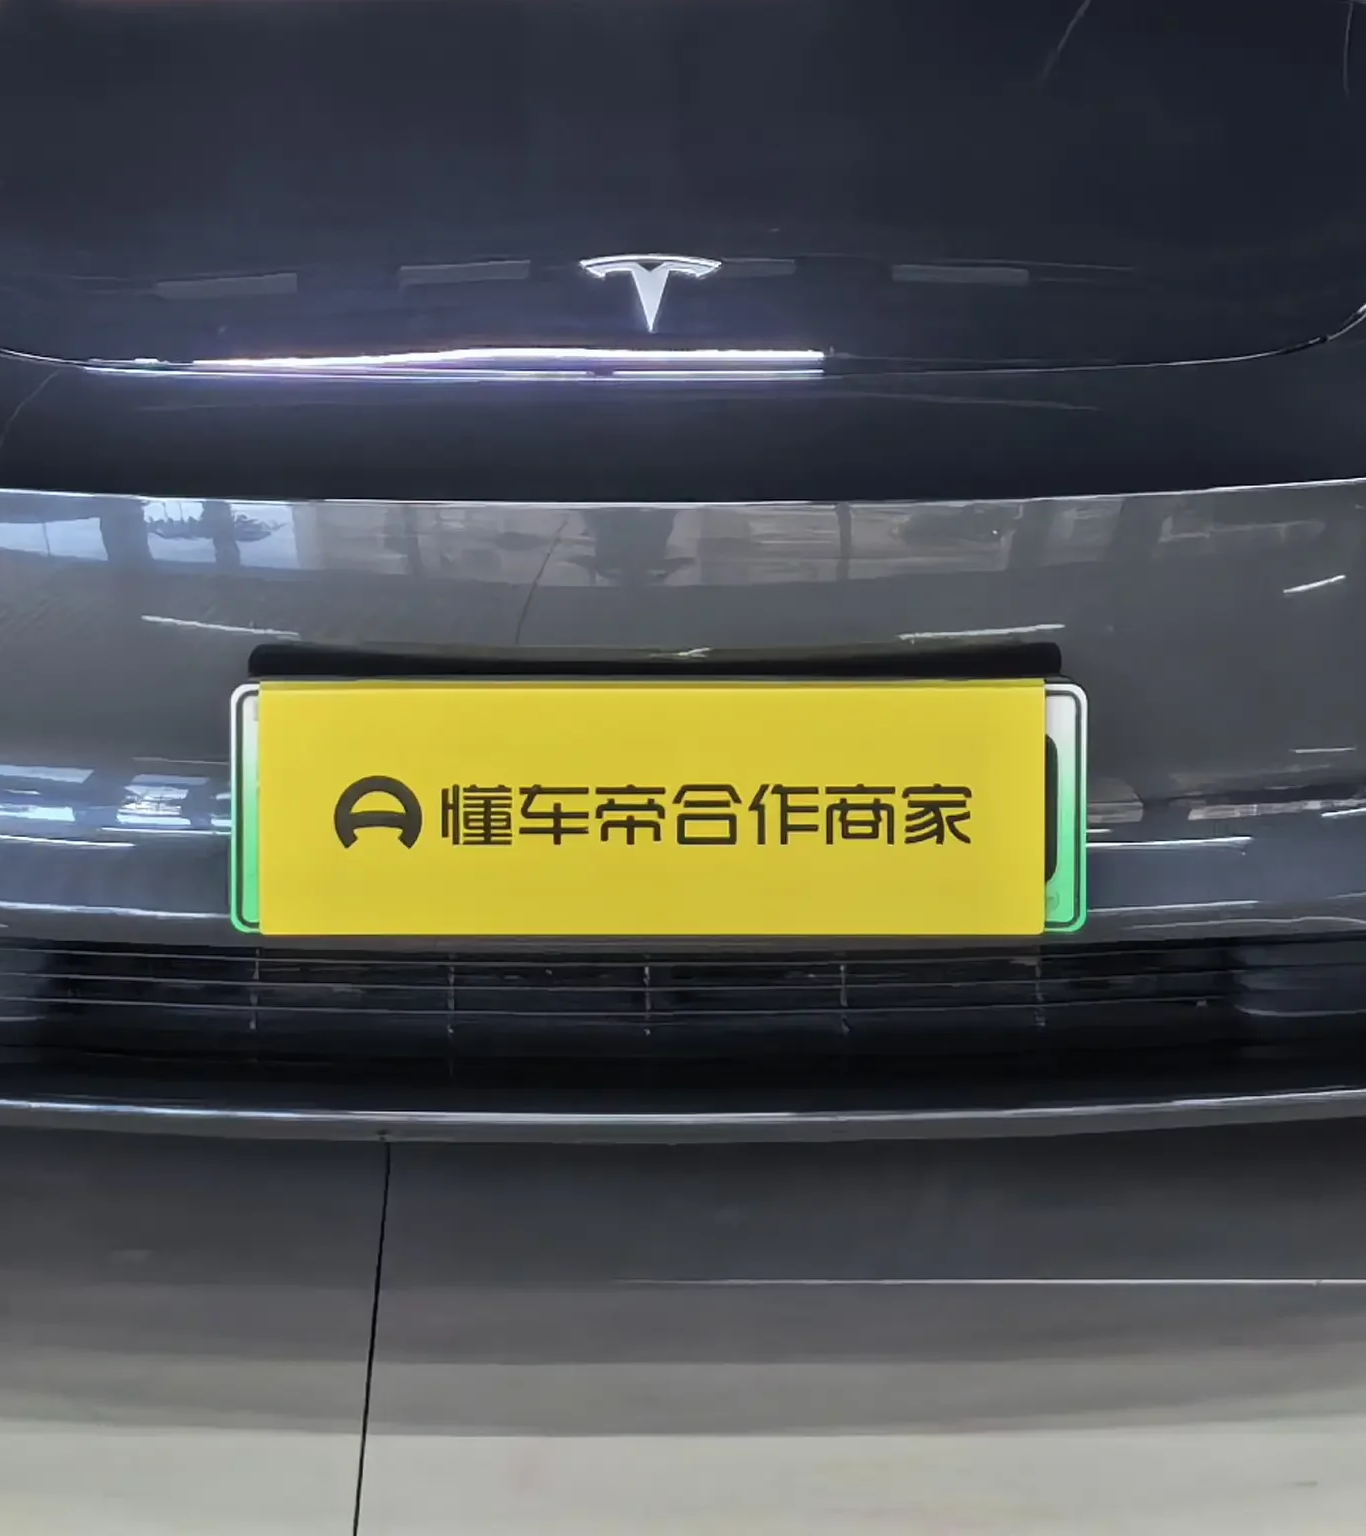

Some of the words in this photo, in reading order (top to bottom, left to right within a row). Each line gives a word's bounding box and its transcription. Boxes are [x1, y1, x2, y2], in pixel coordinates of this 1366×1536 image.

[440, 782, 974, 847] 懂车帝合作商家
